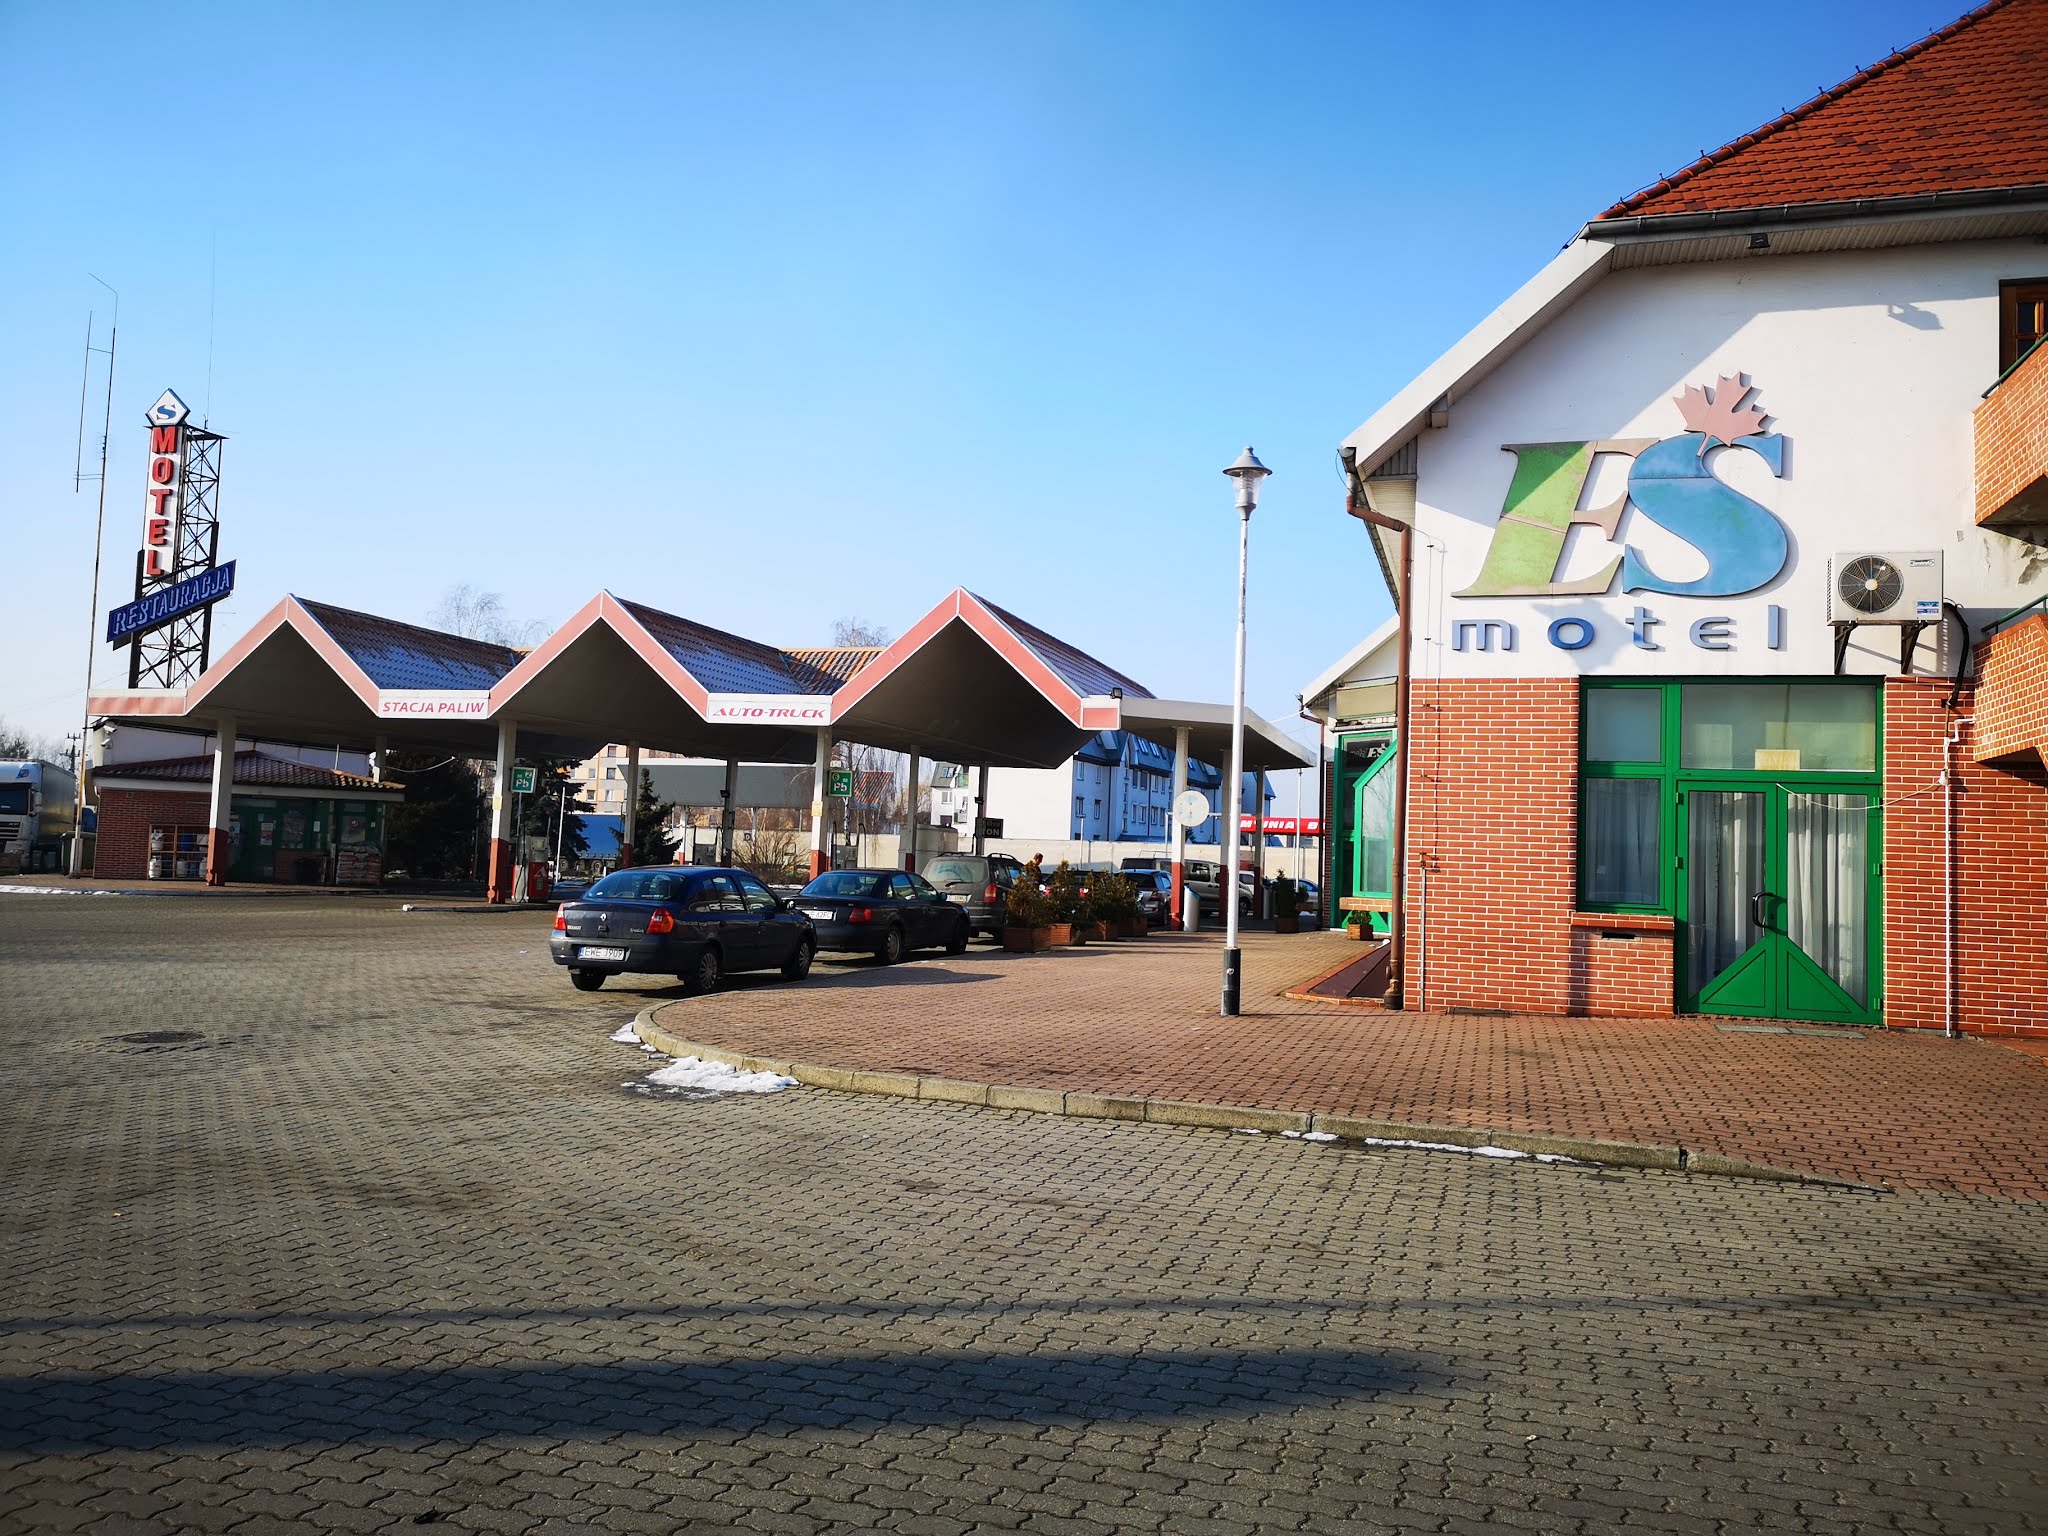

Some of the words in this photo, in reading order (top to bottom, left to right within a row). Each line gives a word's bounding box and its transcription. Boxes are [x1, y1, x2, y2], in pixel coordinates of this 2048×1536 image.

[156, 404, 176, 420] S
[147, 427, 177, 576] MOTEL
[113, 566, 230, 635] RESTAURACJA
[1452, 605, 1780, 650] motel
[382, 701, 435, 714] STACJA
[437, 702, 485, 714] PALIW
[712, 706, 826, 719] AUTO-TRUCK
[516, 778, 529, 788] Pb
[833, 782, 848, 792] Pb
[584, 946, 602, 957] EWE
